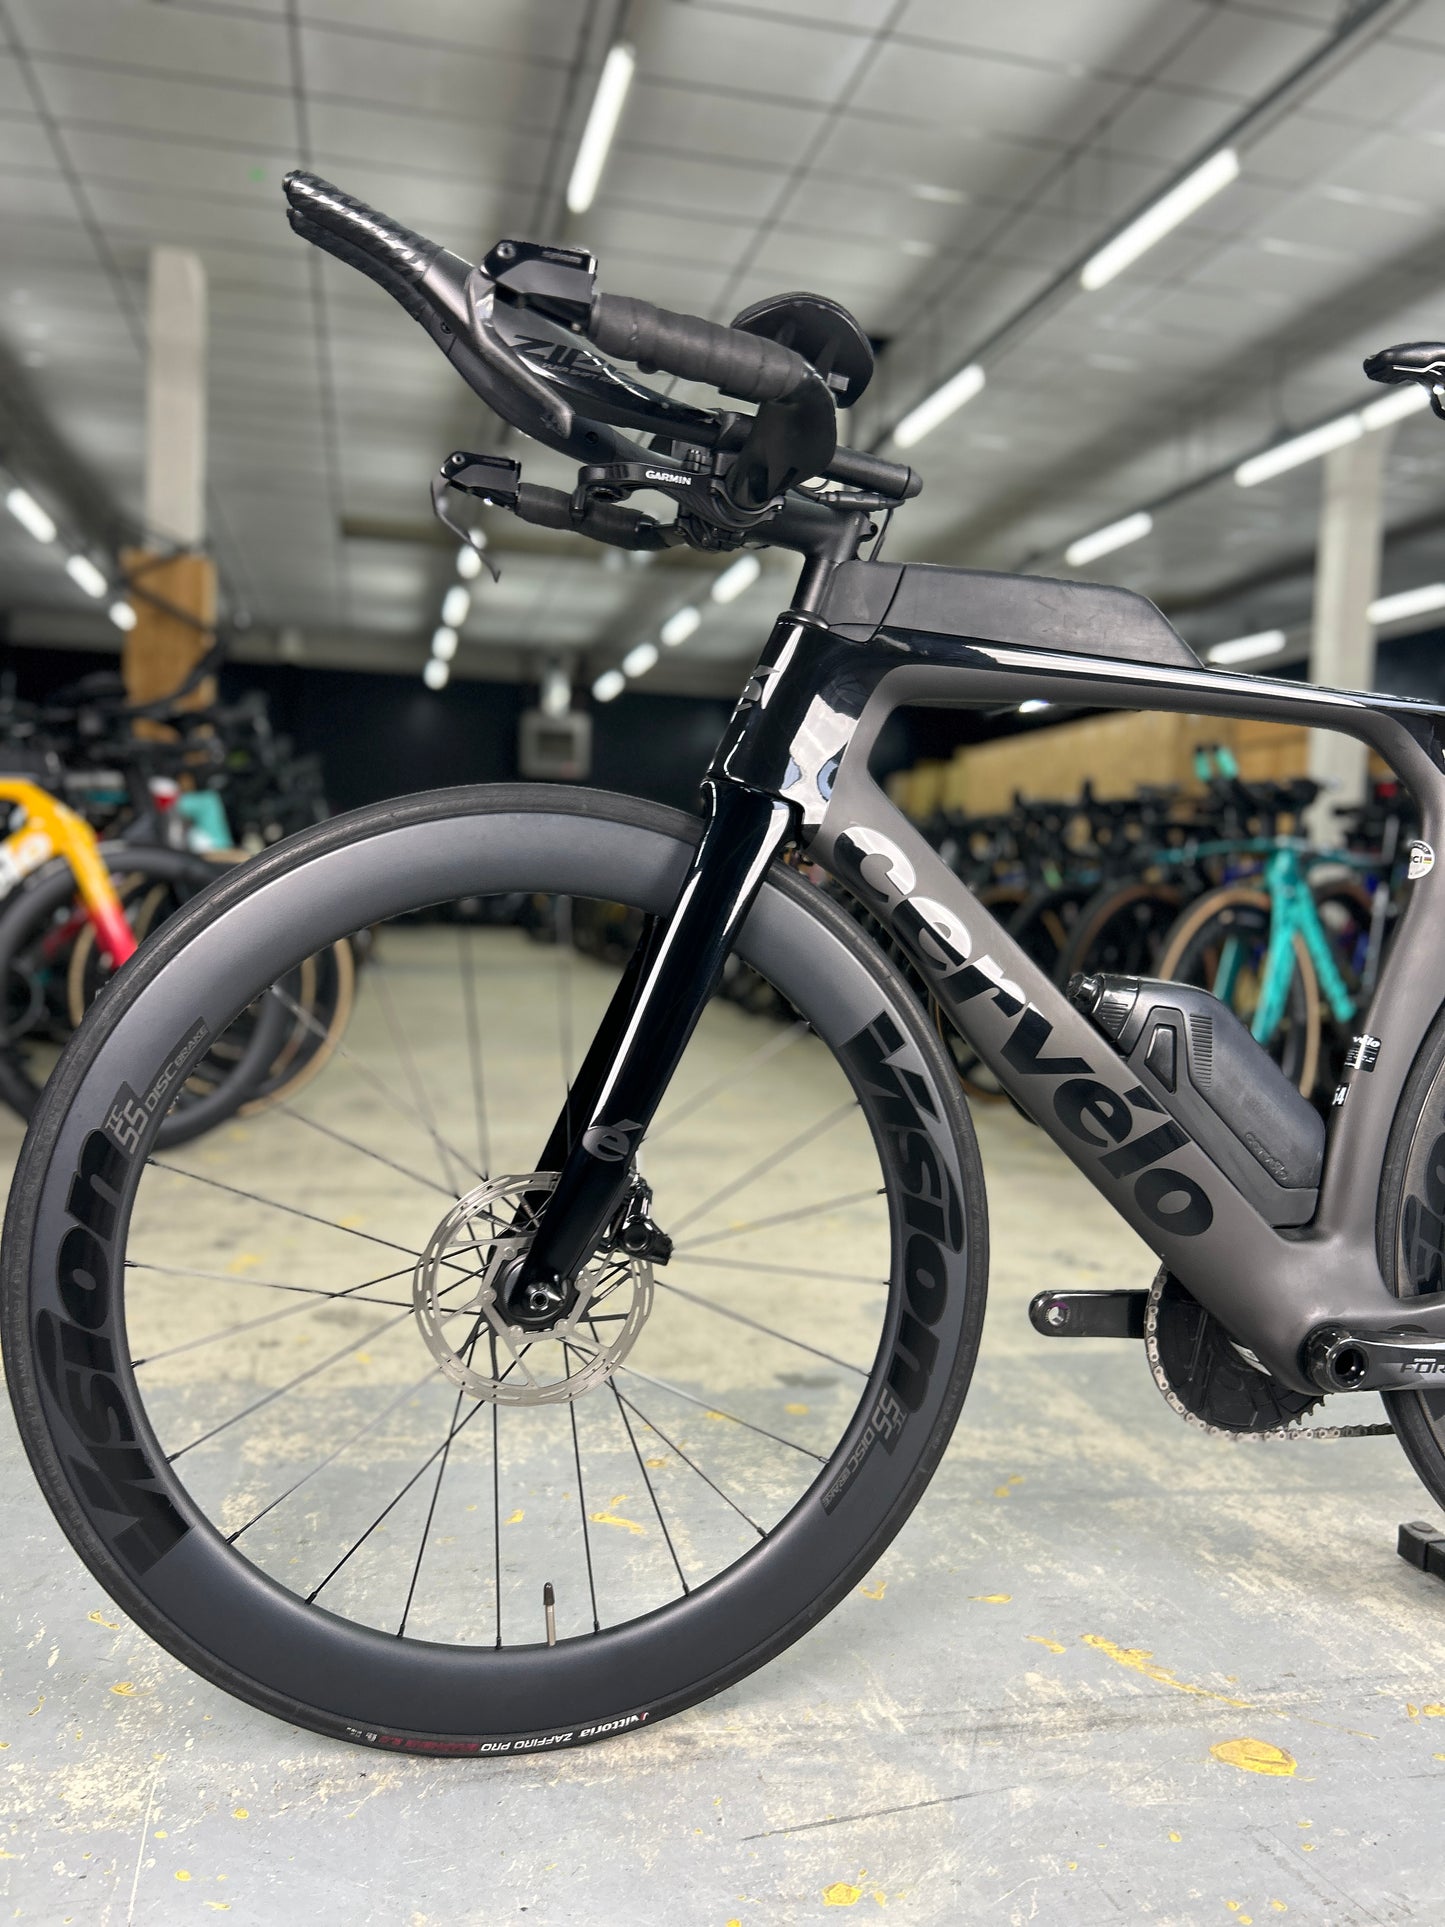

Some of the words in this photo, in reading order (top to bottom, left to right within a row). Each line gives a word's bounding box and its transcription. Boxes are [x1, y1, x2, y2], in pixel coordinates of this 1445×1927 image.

[645, 470, 692, 486] GARMIN
[832, 826, 1214, 1237] cervélo
[112, 1099, 149, 1154] 55
[145, 1062, 180, 1113] DISC
[174, 1024, 209, 1065] BRAKE
[838, 1010, 964, 1413] Vision
[36, 1128, 193, 1576] Vision
[872, 1388, 901, 1440] 55
[846, 1426, 876, 1475] DISC
[480, 1741, 512, 1752] PRO
[514, 1732, 574, 1750] ZAFFIRO
[578, 1714, 640, 1739] vittoria
